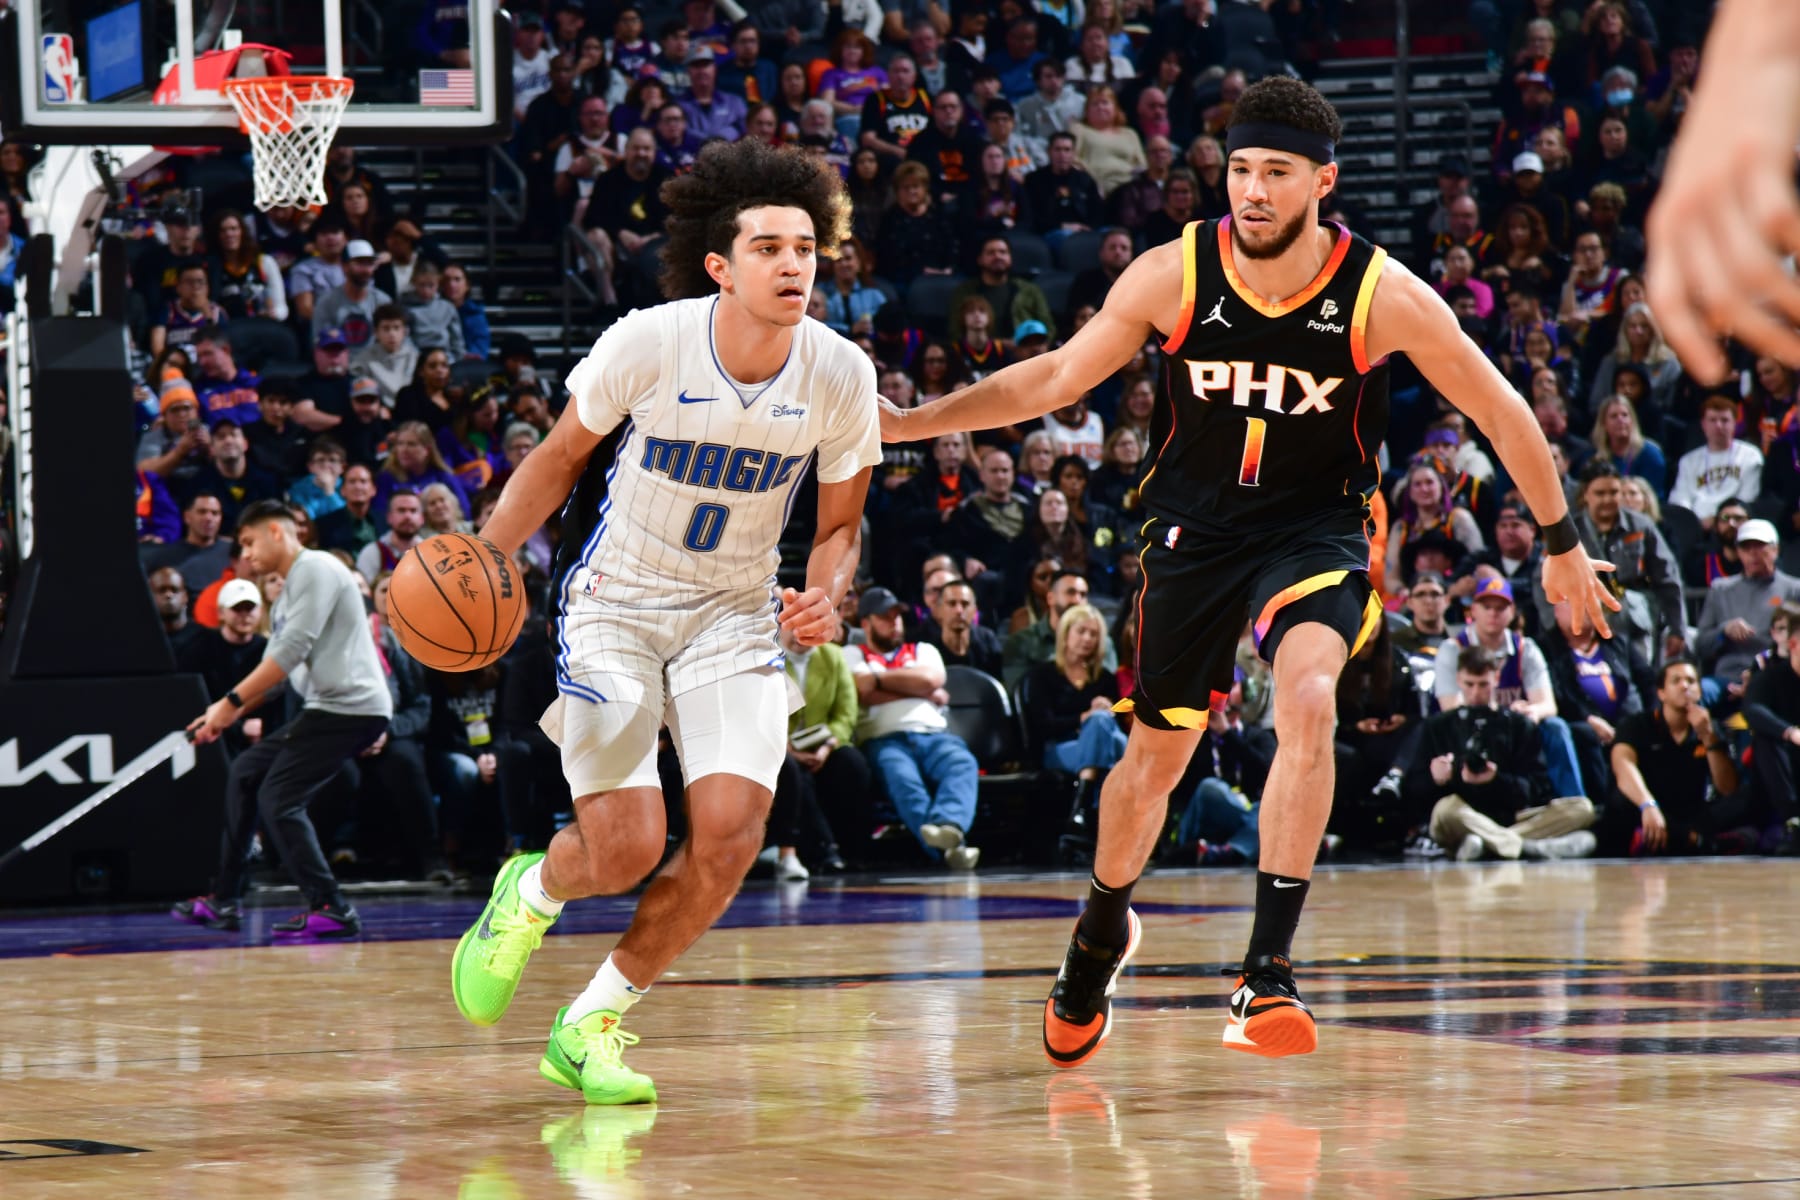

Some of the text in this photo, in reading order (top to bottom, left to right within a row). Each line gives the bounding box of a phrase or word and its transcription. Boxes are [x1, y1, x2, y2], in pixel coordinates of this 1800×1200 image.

[1307, 319, 1345, 334] PayPal
[1184, 358, 1344, 415] PHX
[640, 436, 806, 493] MAGIC
[1238, 416, 1267, 487] 1
[682, 502, 730, 552] 0
[0, 732, 197, 786] KIA
